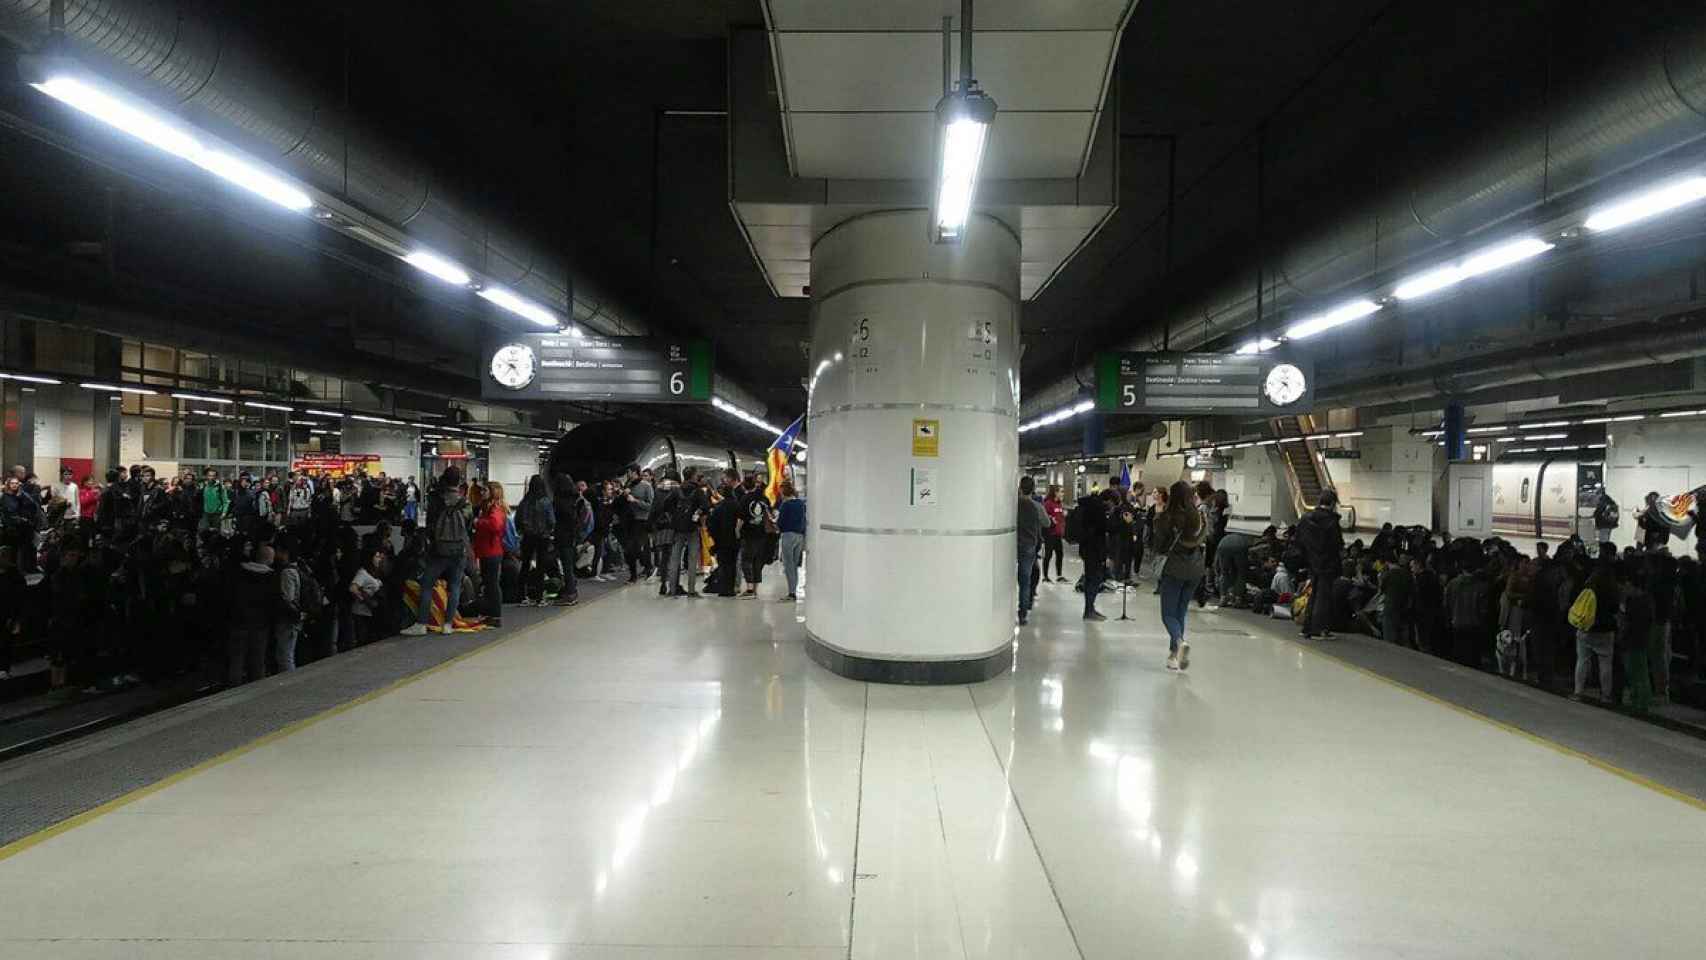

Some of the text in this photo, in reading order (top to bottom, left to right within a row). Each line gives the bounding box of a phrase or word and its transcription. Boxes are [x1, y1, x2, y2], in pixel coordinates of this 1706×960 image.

[860, 318, 869, 341] 6
[671, 371, 684, 394] 6
[1123, 385, 1136, 406] 5
